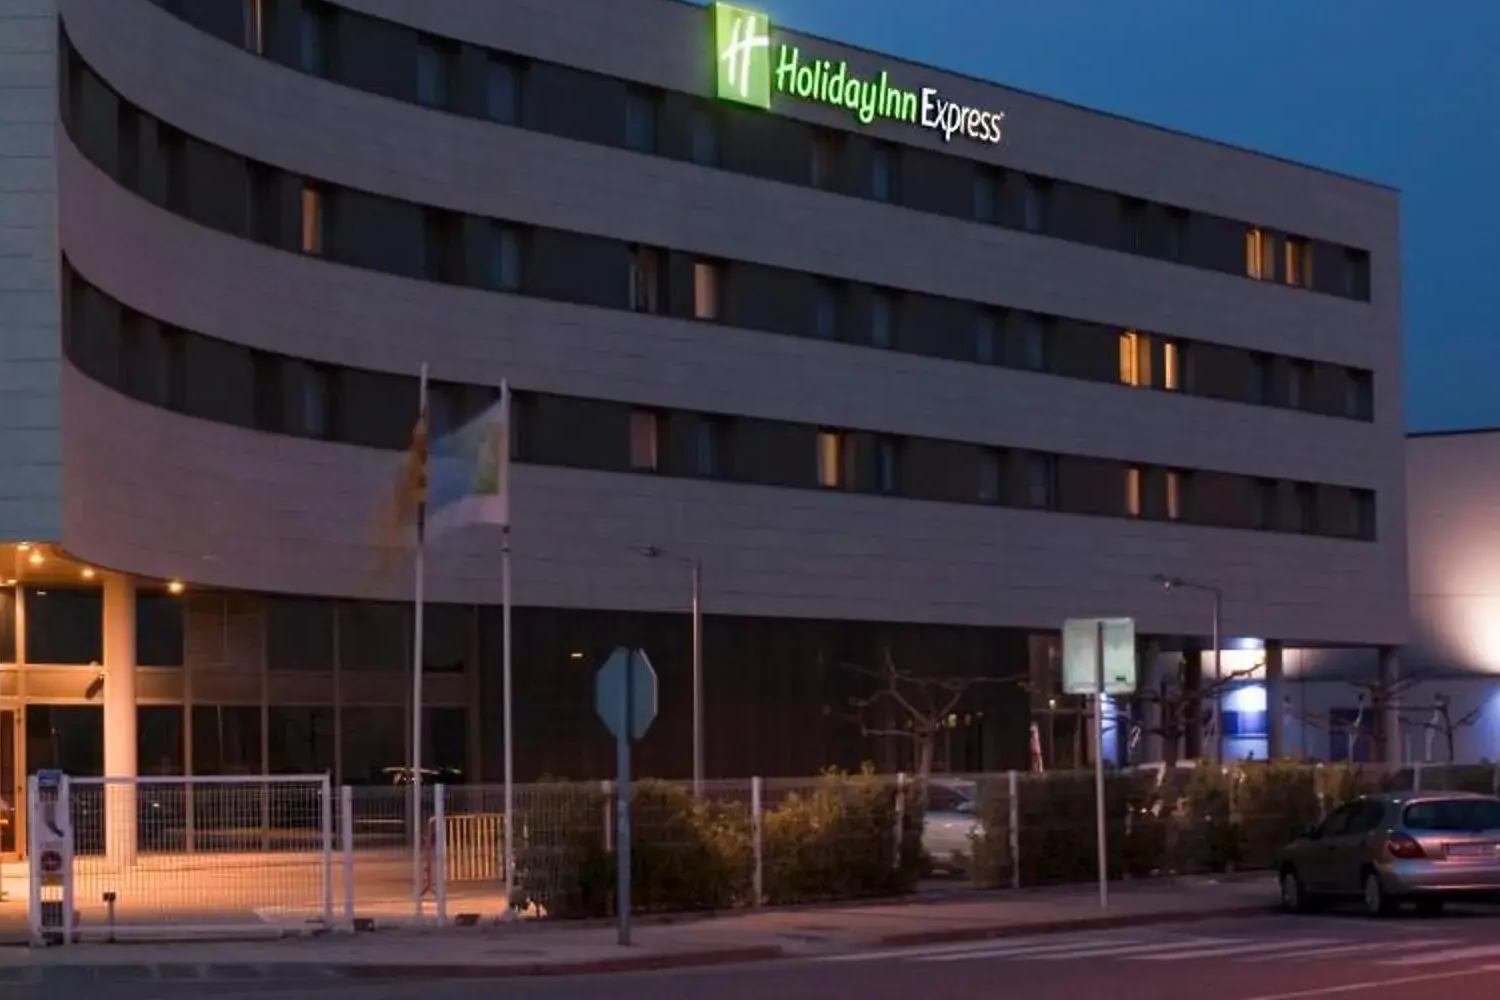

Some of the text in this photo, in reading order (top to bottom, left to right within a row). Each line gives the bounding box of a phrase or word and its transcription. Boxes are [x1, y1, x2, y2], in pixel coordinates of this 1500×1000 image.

[775, 44, 1002, 144] Holiday Inn Express
